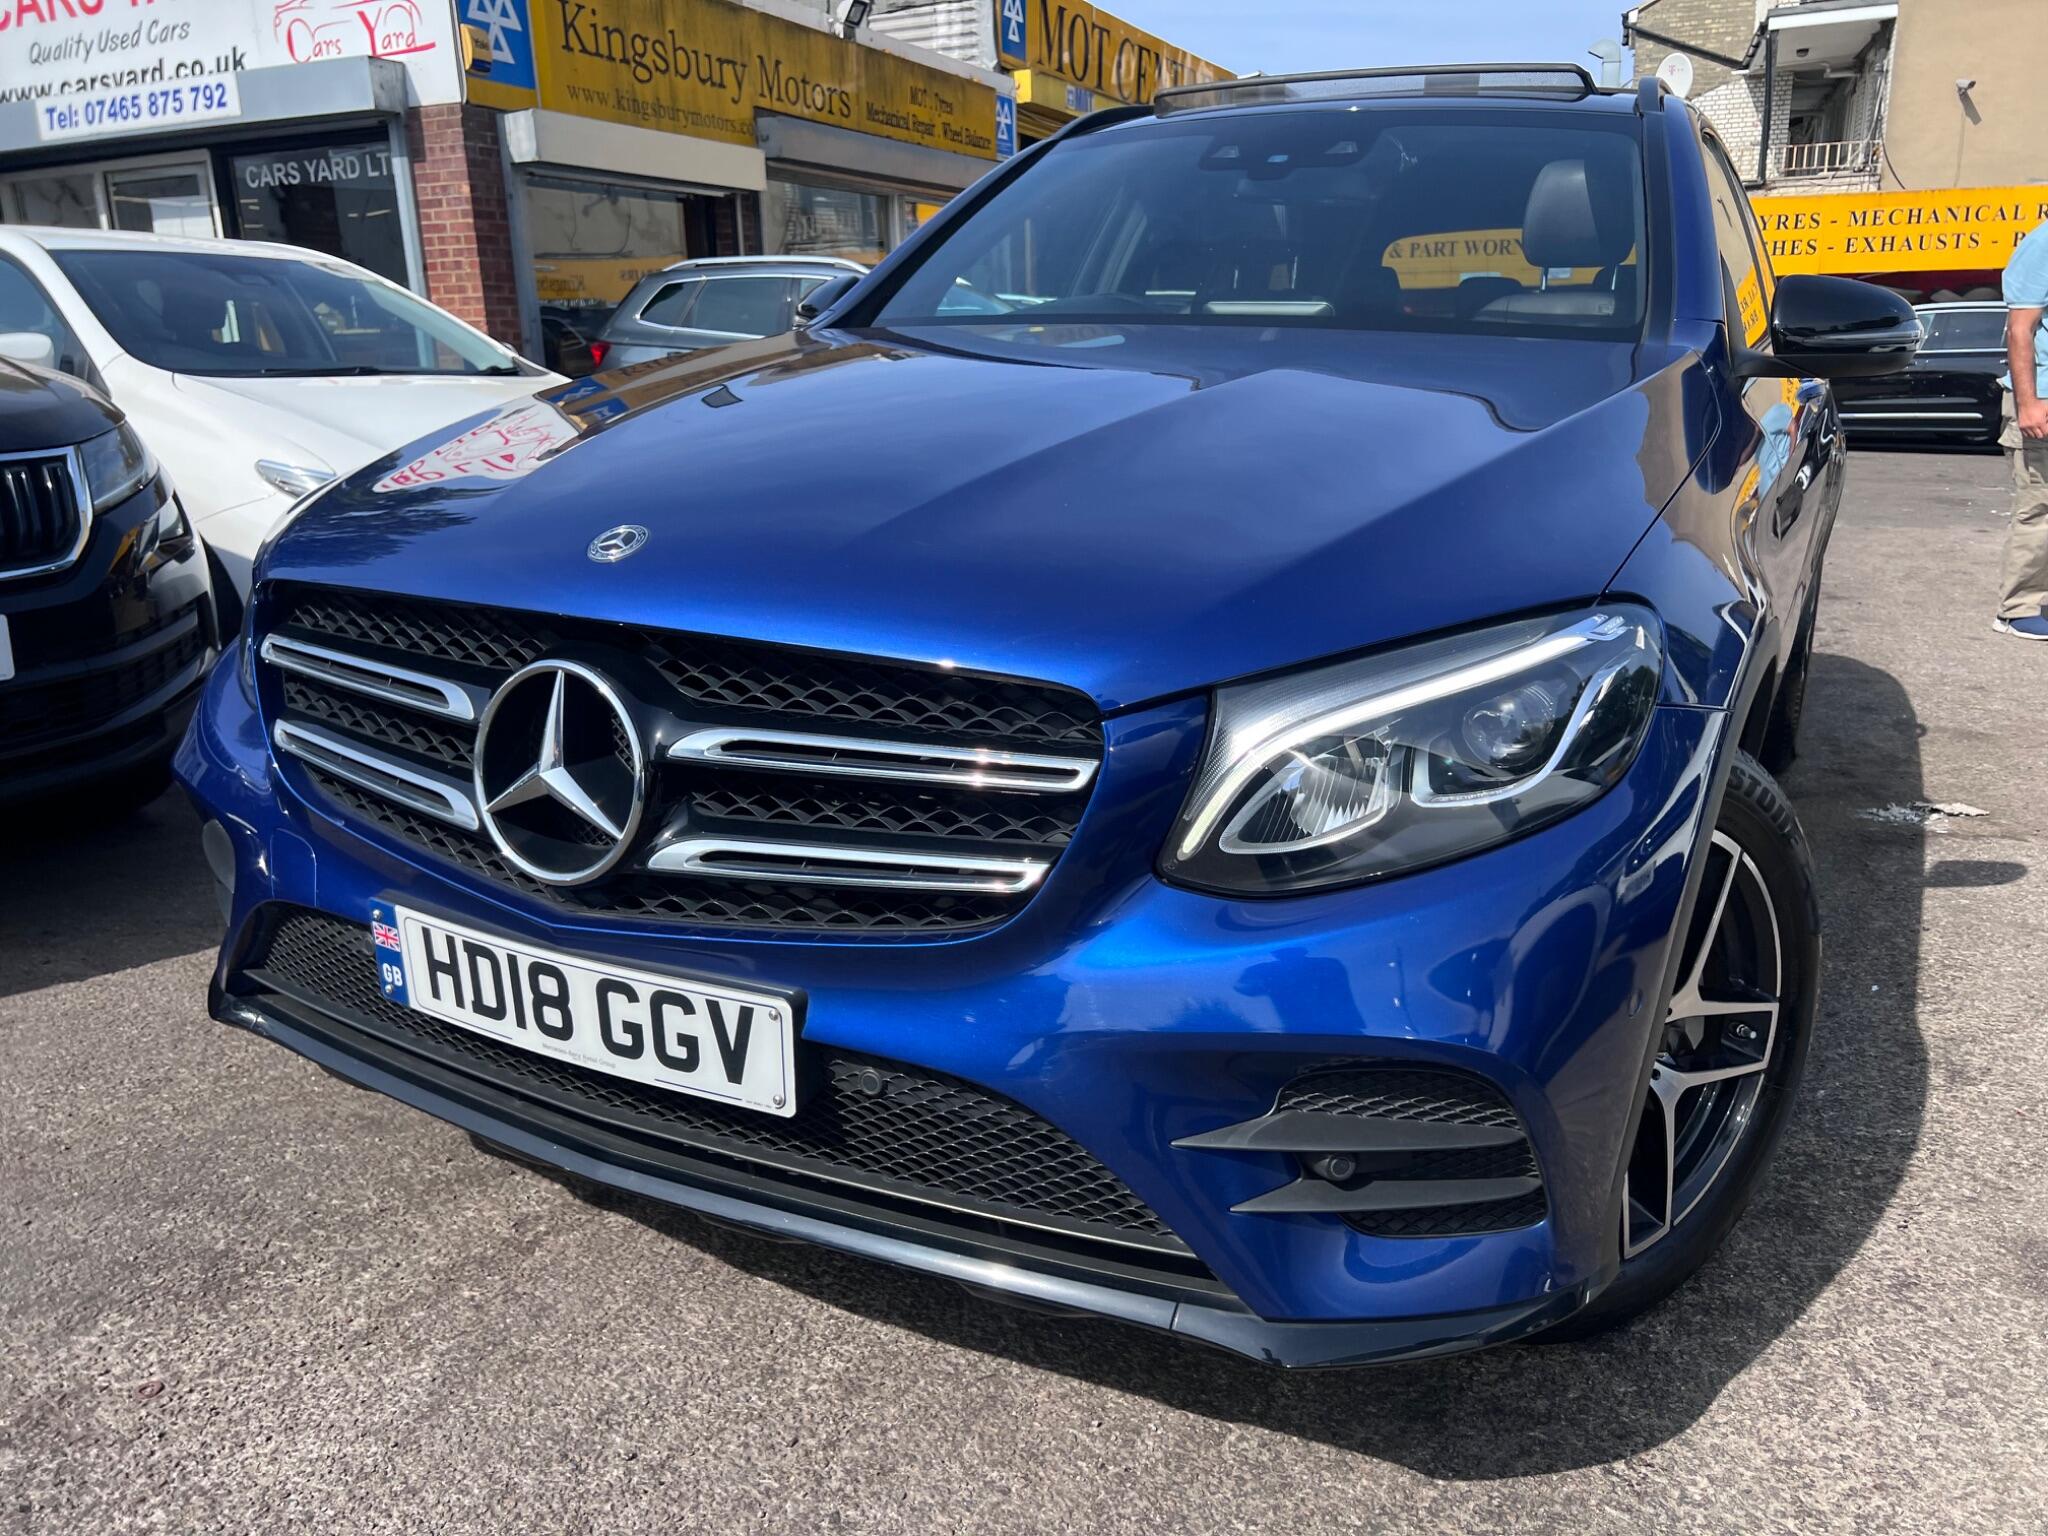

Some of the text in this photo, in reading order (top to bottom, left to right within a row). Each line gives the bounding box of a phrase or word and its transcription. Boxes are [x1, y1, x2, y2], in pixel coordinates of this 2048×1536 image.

[29, 17, 191, 65] Quality Used Cars
[287, 5, 420, 64] Cars Yard
[1038, 0, 1111, 91] MOT
[560, 0, 851, 119] Kingsbury Motors
[45, 82, 228, 131] Tel: 07465 875 792
[246, 161, 300, 188] CARS
[304, 156, 361, 183] YARD
[1759, 212, 1821, 231] YRES
[1848, 204, 2027, 228] MECHANICAL
[1388, 242, 1403, 259] &
[1410, 240, 1458, 259] PART
[1764, 239, 1818, 256] HES
[1844, 231, 1981, 254] EXHAUSTS
[382, 963, 403, 987] GB
[421, 926, 755, 1085] HD18 GGV
